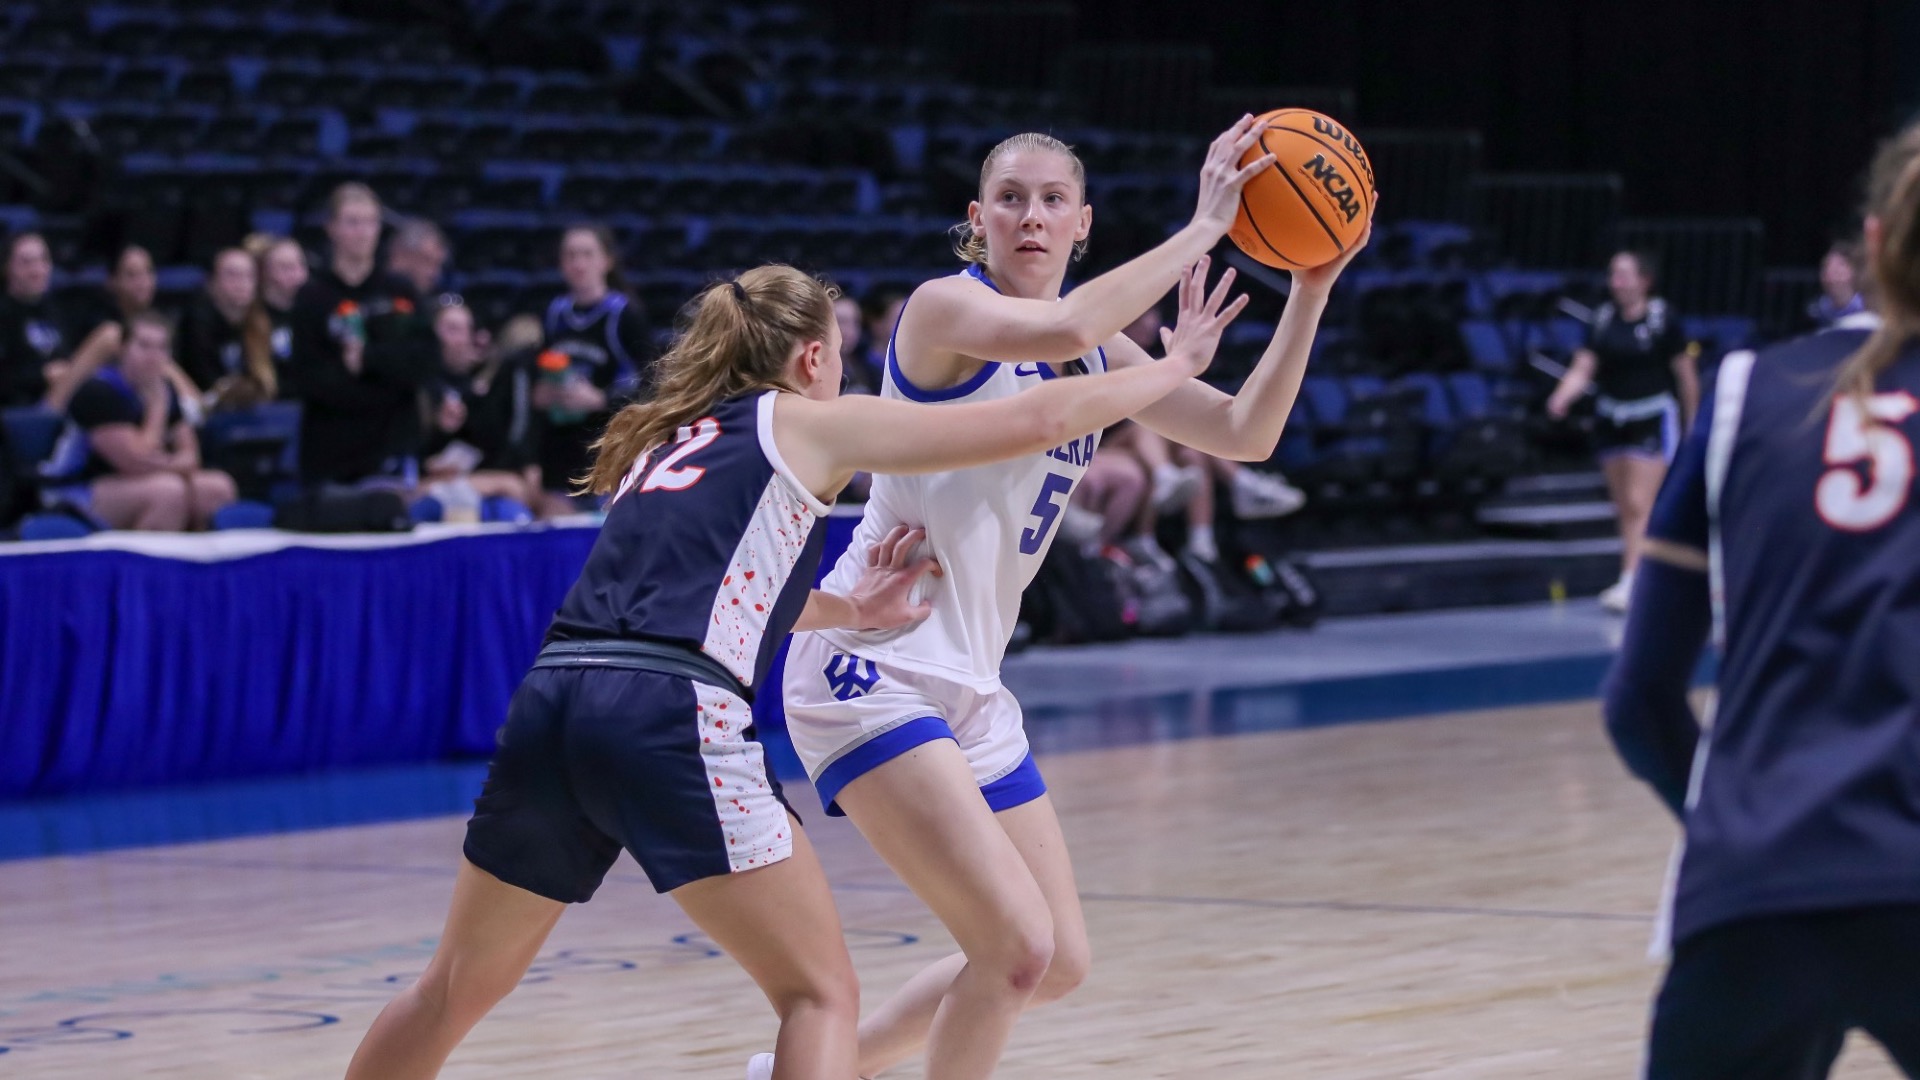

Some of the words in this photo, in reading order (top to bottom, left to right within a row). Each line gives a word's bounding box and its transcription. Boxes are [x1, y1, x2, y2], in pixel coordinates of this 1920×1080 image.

[1302, 153, 1361, 224] NCAA
[1312, 116, 1375, 195] Wilso
[1814, 388, 1919, 534] 5
[1018, 471, 1074, 556] 5
